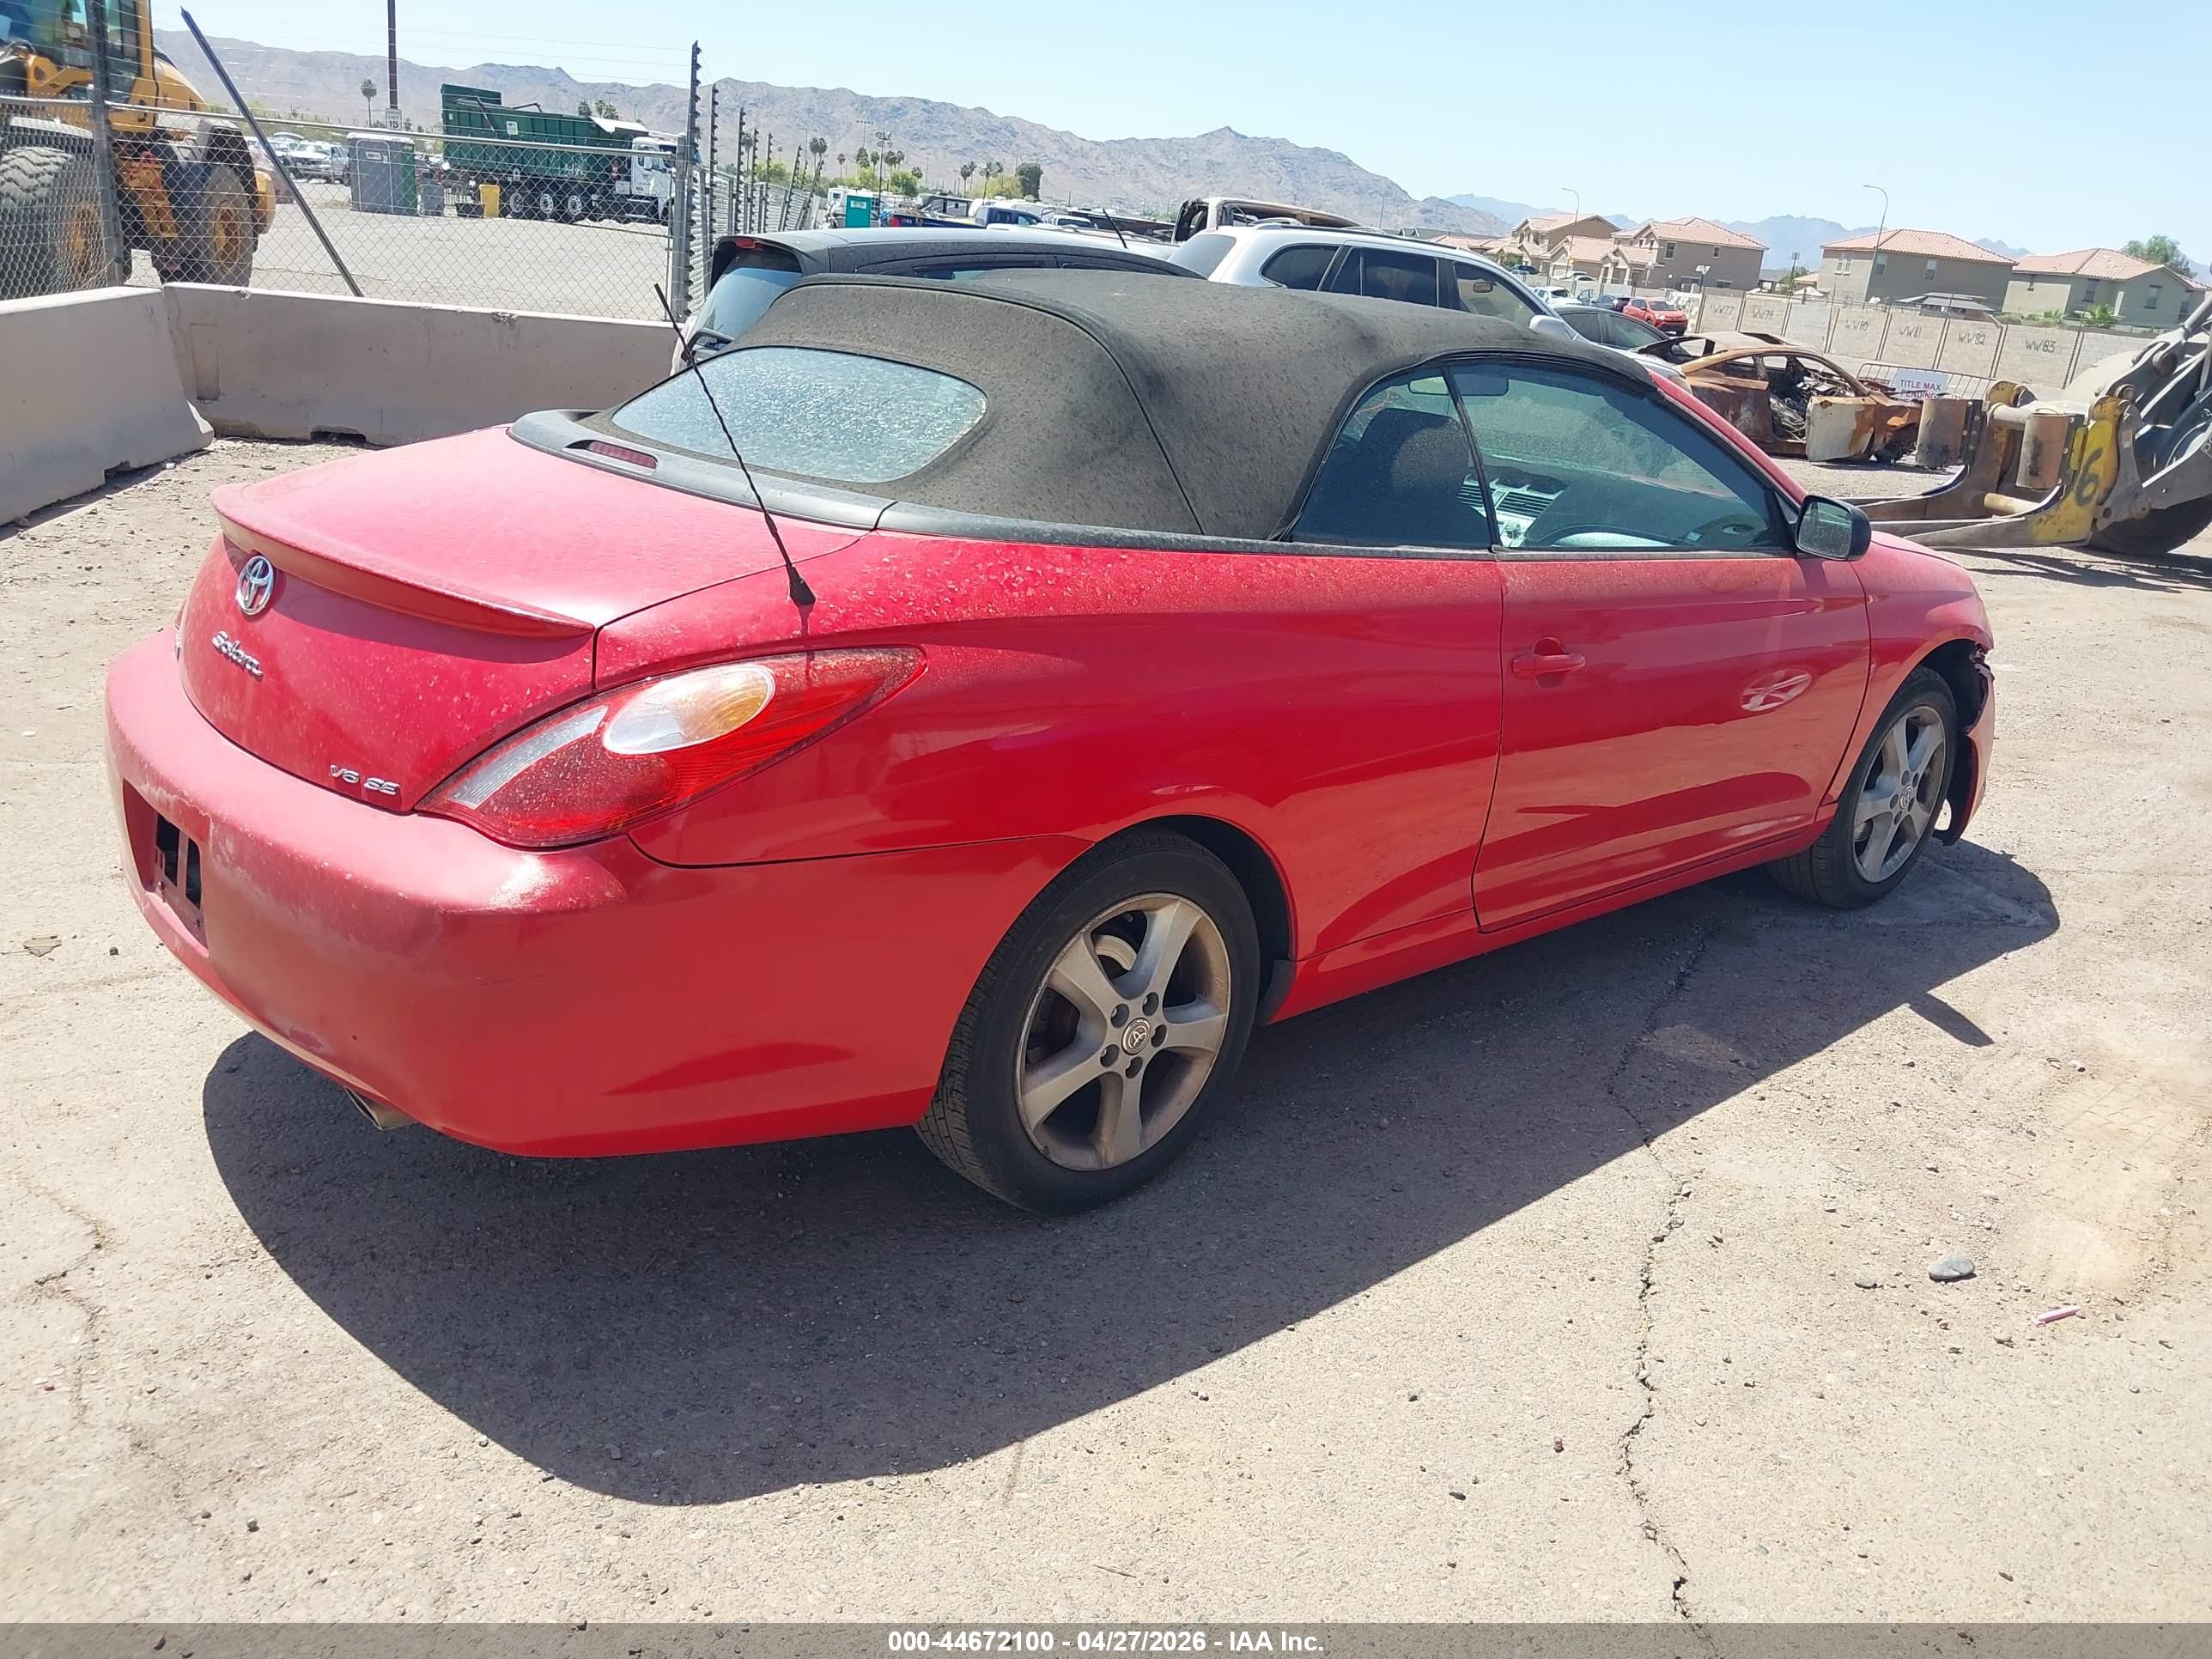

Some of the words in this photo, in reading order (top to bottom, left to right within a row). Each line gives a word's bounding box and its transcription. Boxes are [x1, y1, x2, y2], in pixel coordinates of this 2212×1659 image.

[1845, 319, 1869, 331] WW80
[1899, 325, 1921, 338] WW81
[1959, 331, 1985, 345] WW82
[2026, 339, 2057, 353] WW83
[1900, 380, 1921, 389] TITLE
[1923, 382, 1942, 391] MAX
[2075, 448, 2102, 507] 6
[212, 630, 263, 676] Solara
[330, 764, 360, 783] V6
[363, 777, 400, 795] SE
